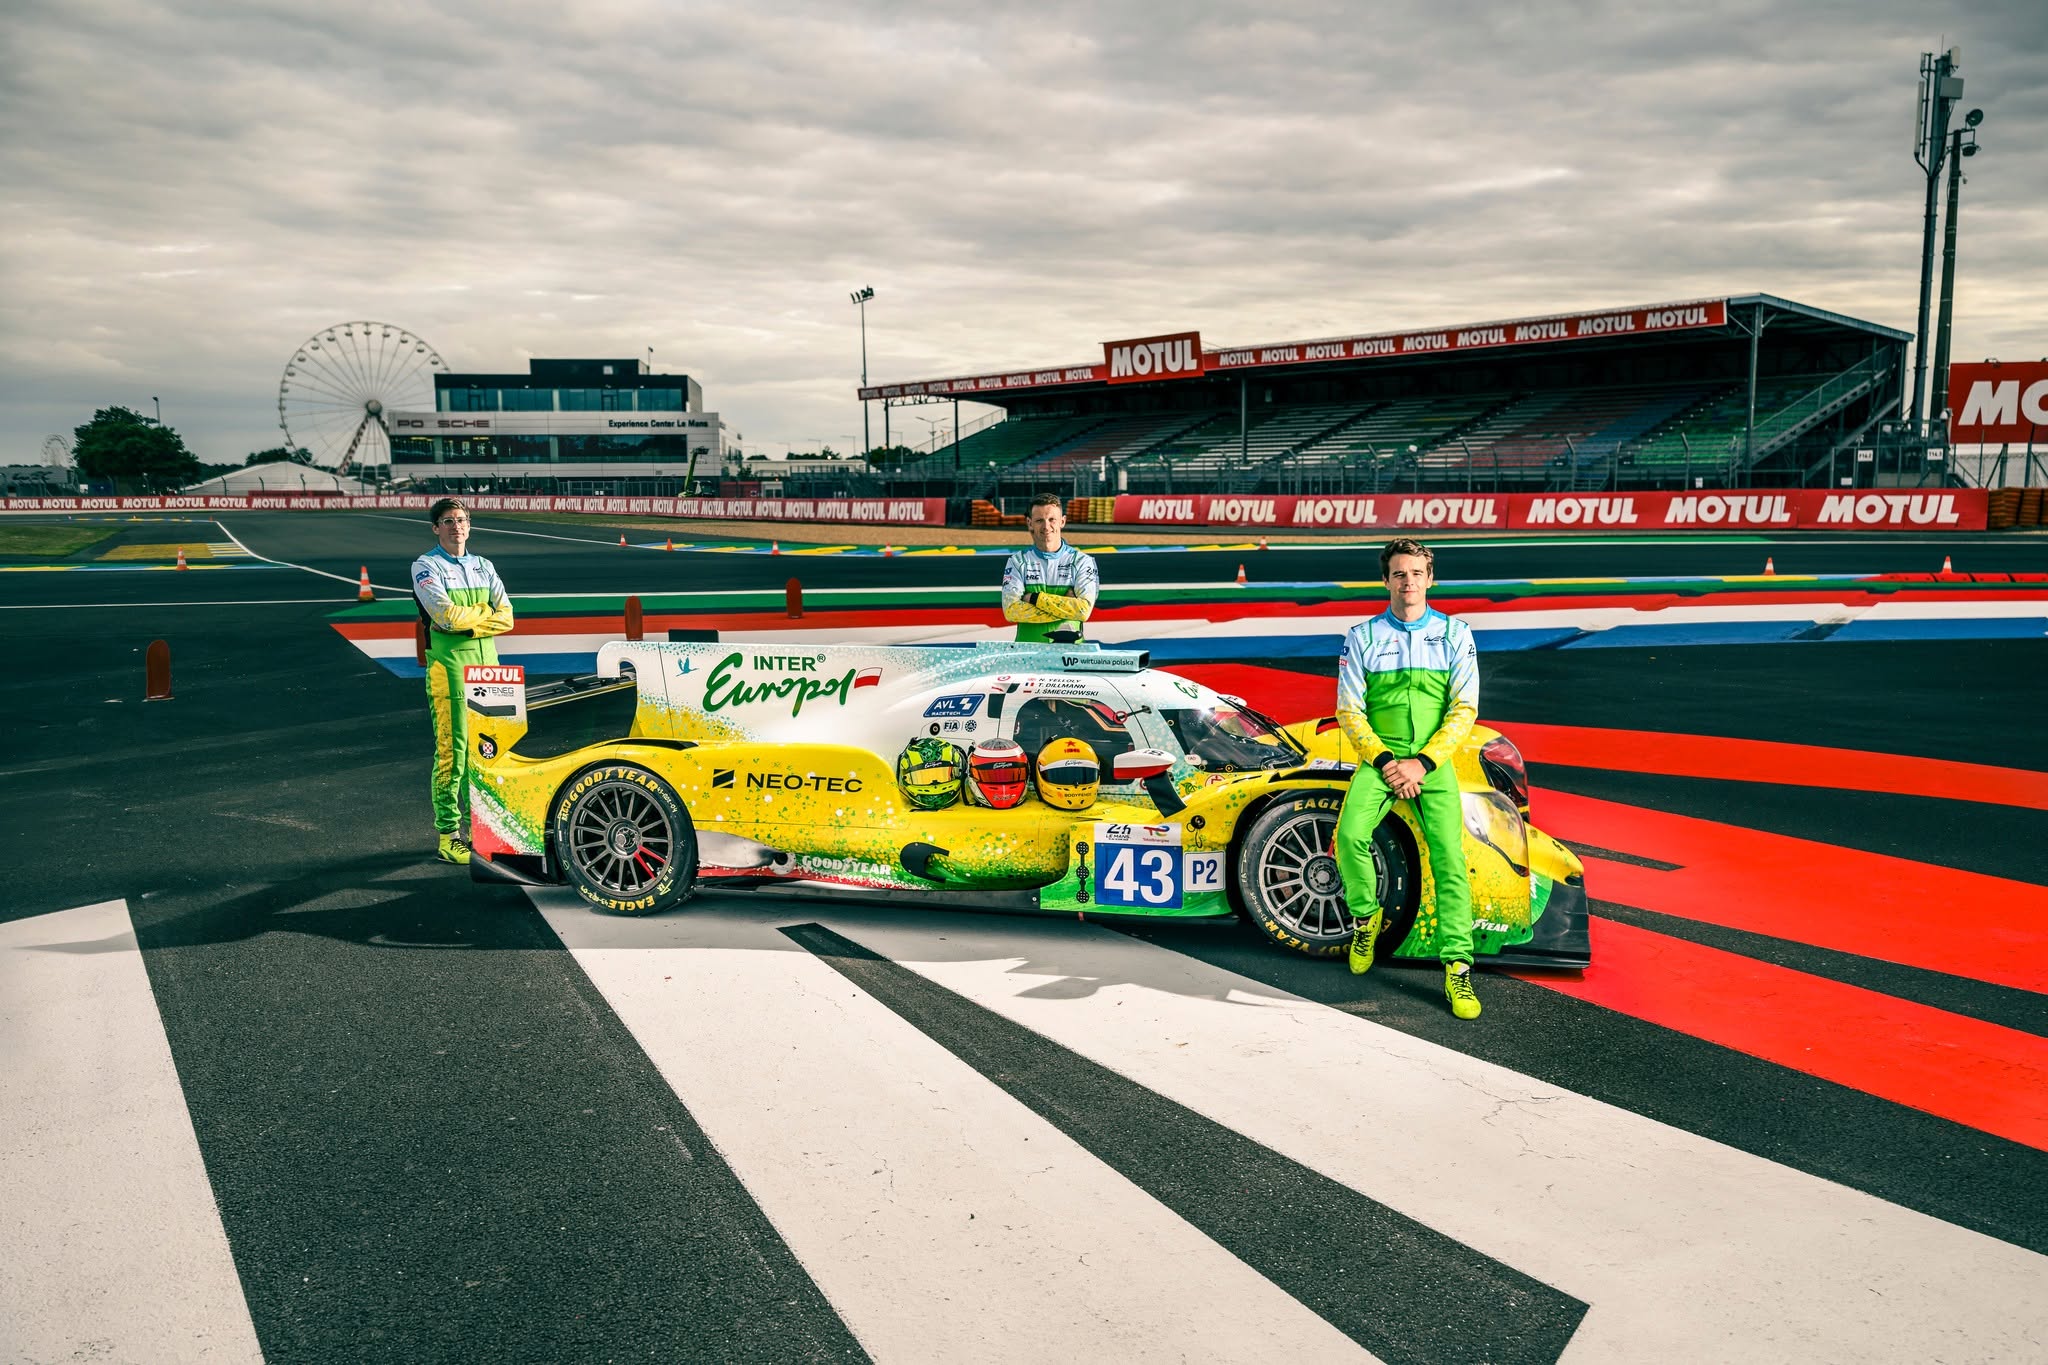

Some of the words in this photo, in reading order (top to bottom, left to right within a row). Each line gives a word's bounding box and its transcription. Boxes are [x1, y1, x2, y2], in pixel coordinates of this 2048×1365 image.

[1219, 351, 1255, 366] MOTUL
[1261, 348, 1299, 363] MOTUL
[1305, 344, 1345, 359] MOTUL
[1352, 339, 1396, 355] MOTUL
[1403, 334, 1449, 351] MOTUL
[1457, 328, 1506, 347] MOTUL
[1515, 321, 1568, 342] MOTUL
[1578, 314, 1635, 336] MOTUL
[1646, 307, 1707, 329] MOTUL
[1111, 339, 1197, 377] MOTUL
[905, 385, 924, 394] MOTUL
[928, 383, 949, 392] MOTUL
[953, 380, 976, 391] MOTUL
[979, 377, 1002, 388] MOTUL
[1006, 375, 1031, 386] MOTUL
[1035, 371, 1061, 384] MOTUL
[1065, 368, 1094, 381] MOTUL
[609, 420, 649, 428] Experience
[9, 499, 40, 509] MOTUL
[43, 499, 78, 509] MOTUL
[81, 499, 118, 509] MOTUL
[122, 498, 161, 508] MOTUL
[165, 497, 205, 508] MOTUL
[209, 497, 248, 508] MOTUL
[252, 498, 287, 508] MOTUL
[290, 498, 321, 508] MOTUL
[324, 498, 350, 508] MOTUL
[352, 498, 377, 508] MOTUL
[379, 498, 400, 507] MOTUL
[403, 497, 426, 508] MOTUL
[477, 498, 500, 508] MOTUL
[503, 498, 527, 509] MOTUL
[530, 498, 550, 510] MOTUL
[554, 498, 581, 510] MOTUL
[583, 498, 604, 511] MOTUL
[607, 498, 627, 511] MOTUL
[630, 499, 650, 512] MOTUL
[653, 499, 673, 513] MOTUL
[676, 500, 698, 514] MOTUL
[701, 500, 724, 515] MOTUL
[727, 501, 752, 516] MOTUL
[755, 501, 783, 517] MOTUL
[785, 501, 815, 518] MOTUL
[817, 502, 849, 519] MOTUL
[851, 502, 886, 520] MOTUL
[888, 502, 925, 520] MOTUL
[1139, 499, 1194, 520] MOTUL
[1207, 499, 1276, 523] MOTUL
[1293, 499, 1377, 524] MOTUL
[1398, 498, 1497, 524] MOTUL
[1527, 498, 1638, 524] MOTUL
[1665, 495, 1790, 523] MOTUL
[1817, 495, 1959, 523] MOTUL
[1080, 657, 1111, 666] wirtualna
[1112, 658, 1134, 667] polska
[467, 667, 521, 682] MOTUL
[702, 652, 856, 718] Europol
[934, 700, 955, 709] AVL
[944, 722, 959, 730] FIA
[569, 768, 659, 802] GOODYEAR
[746, 772, 863, 793] NEO-TEC
[481, 788, 529, 838] GOODYEAR
[1294, 799, 1340, 811] EAGL
[802, 855, 891, 875] GOODYEAR
[1104, 848, 1175, 904] 43
[1192, 859, 1218, 885] P2
[607, 895, 656, 911] EAGLE
